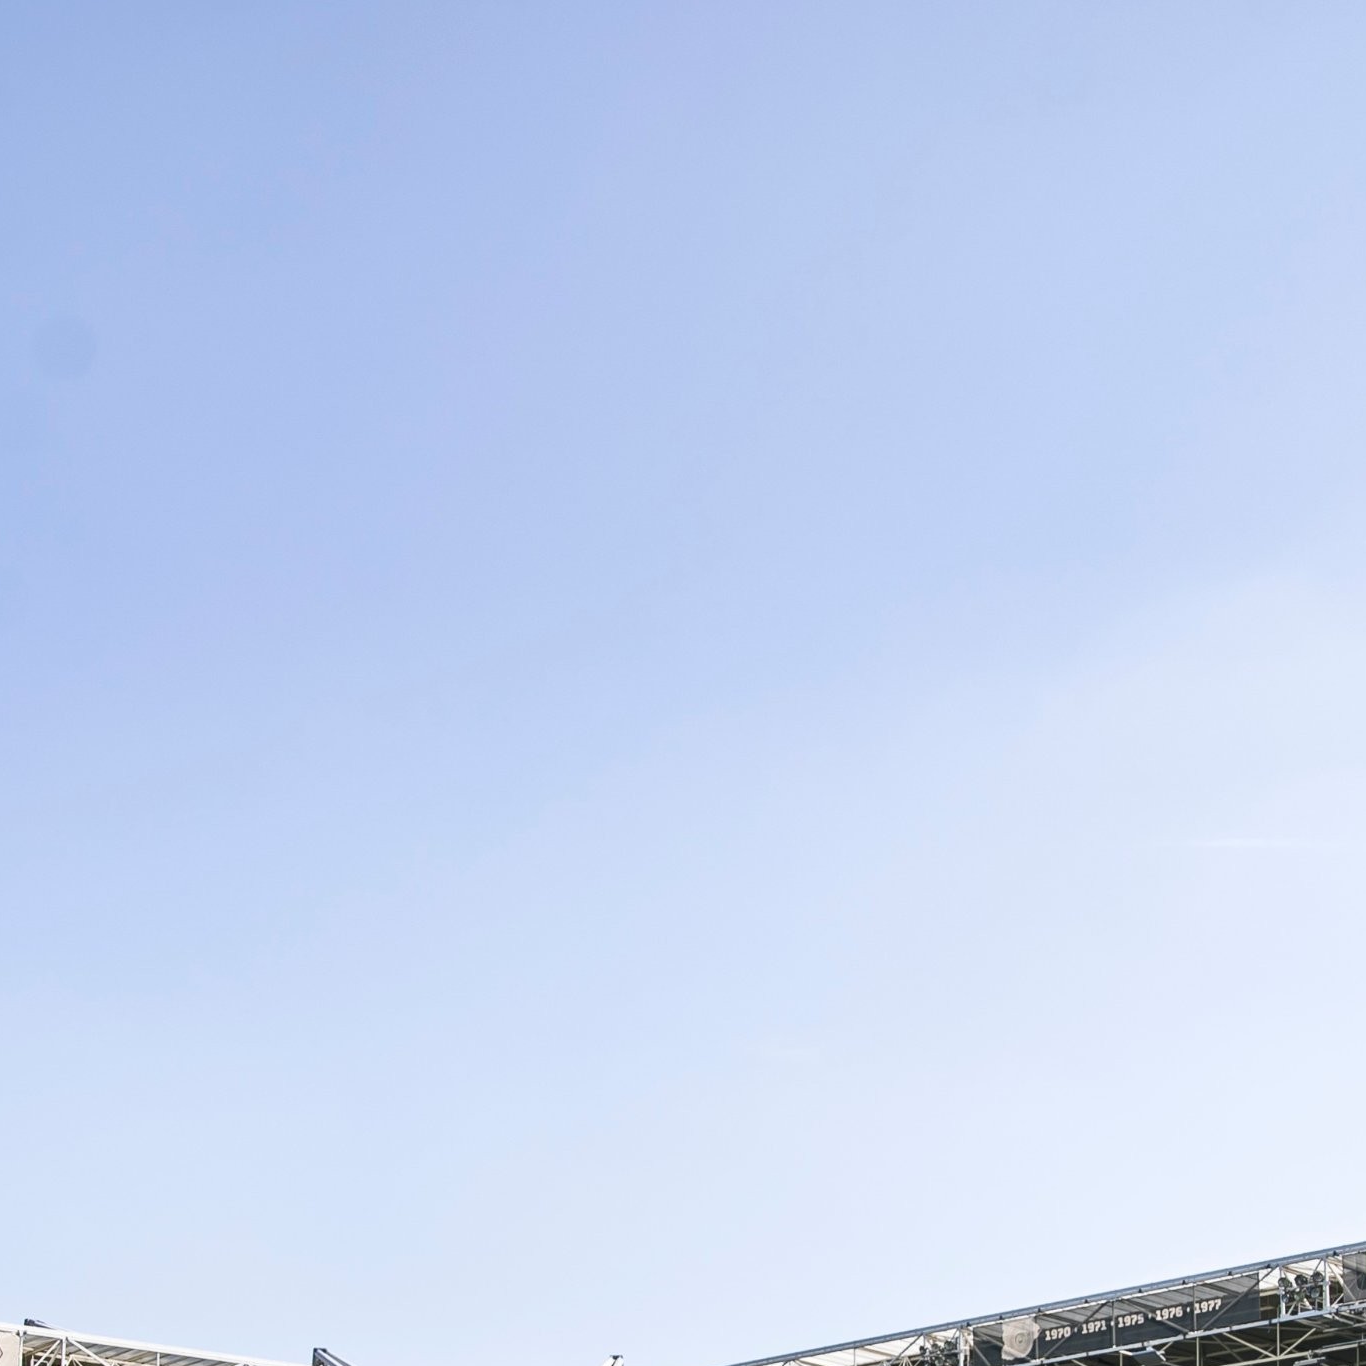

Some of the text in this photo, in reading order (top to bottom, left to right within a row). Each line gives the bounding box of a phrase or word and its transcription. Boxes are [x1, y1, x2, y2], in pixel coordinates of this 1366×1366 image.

[1045, 1299, 1222, 1341] 1970 1971 1975 1976 1977
